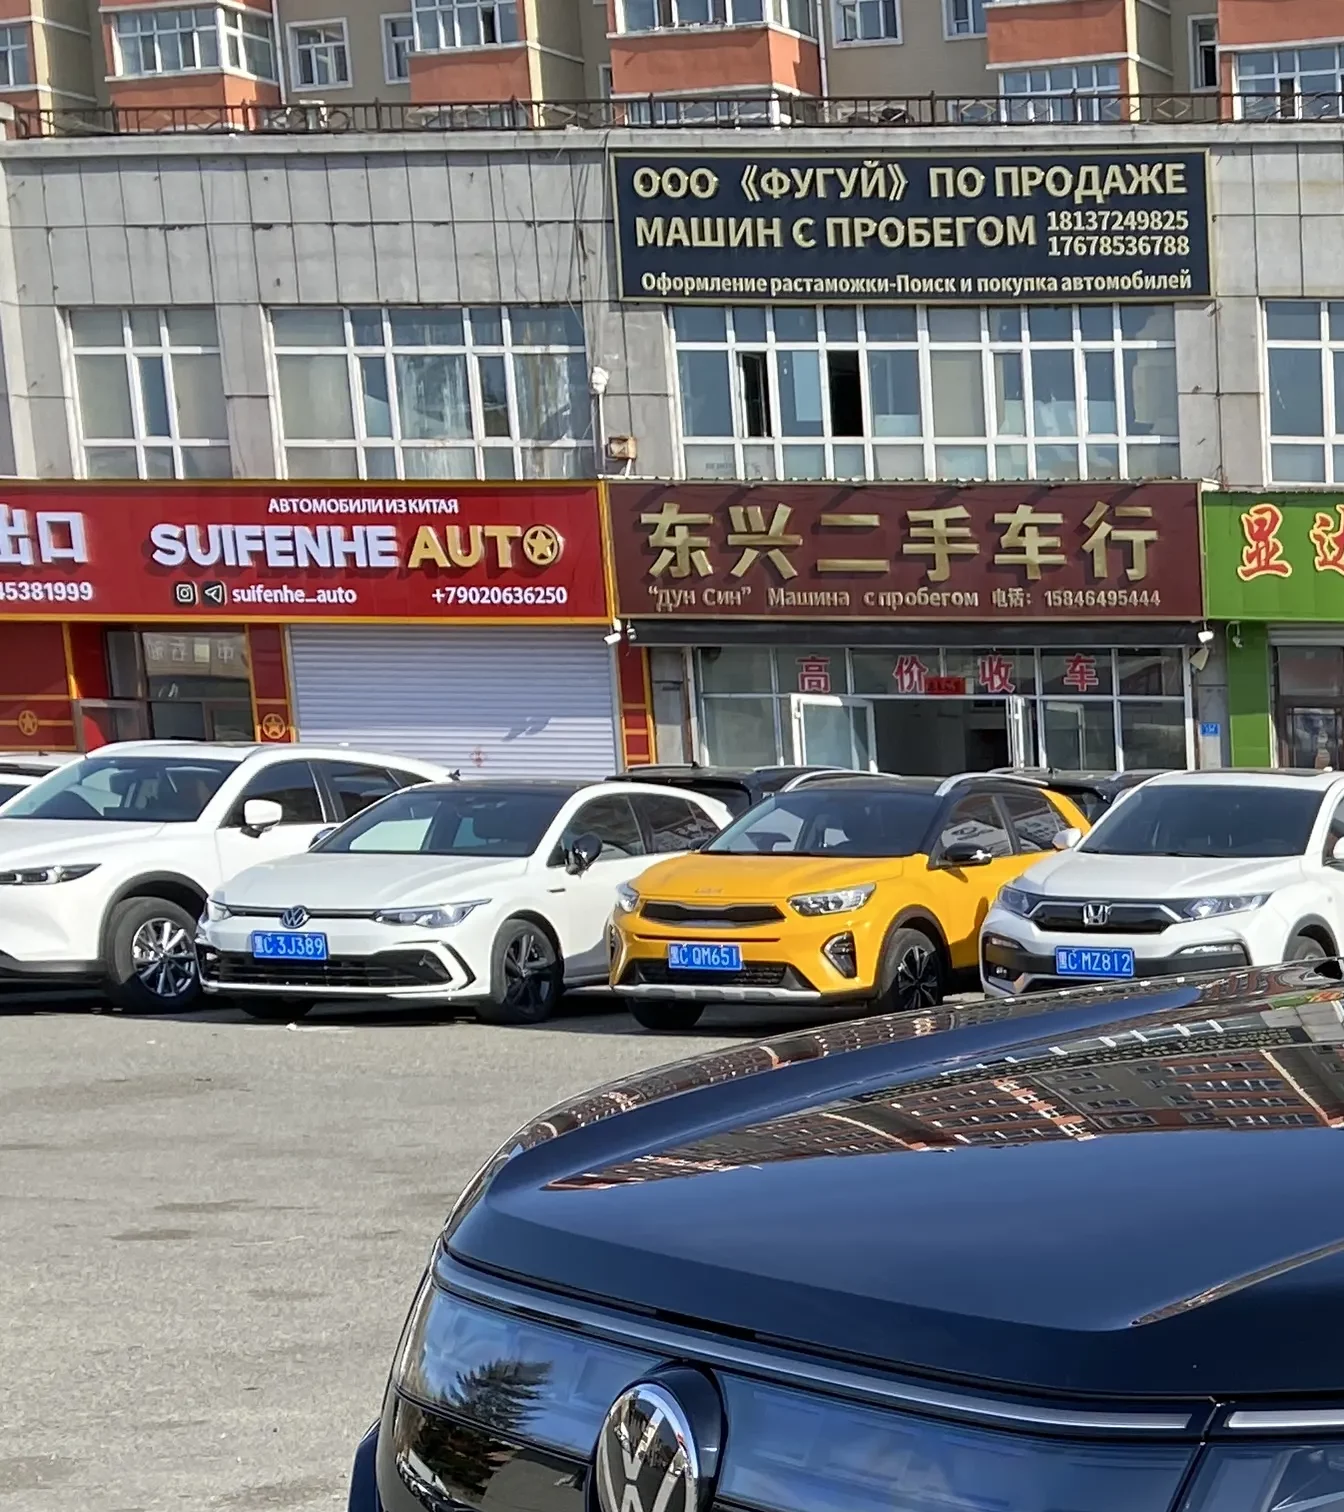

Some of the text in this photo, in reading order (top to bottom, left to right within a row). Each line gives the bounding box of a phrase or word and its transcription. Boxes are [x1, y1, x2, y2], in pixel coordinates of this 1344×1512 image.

[633, 167, 717, 199] ООО
[929, 167, 985, 198] ПО
[995, 163, 1188, 203] ПРОДАЖЕ
[636, 215, 1037, 248] МАШИН С ПРОБЕГОМ
[1046, 210, 1189, 232] 18137249825
[1048, 235, 1190, 257] 17678536788
[641, 272, 769, 296] Оформление
[960, 278, 973, 292] и
[976, 277, 1058, 297] покупка
[1061, 269, 1192, 294] автомобилей
[268, 498, 459, 515] АВТОМОБИЛИ ИЗ КИТАЯ
[0, 503, 88, 565] 出口
[150, 523, 400, 568] SUIFENHE
[640, 502, 1159, 581] 东兴二手车行
[231, 585, 568, 606] suifenhe_auto +79020636250
[768, 588, 850, 608] Машина
[878, 590, 979, 611] пробегом
[1044, 587, 1161, 608] 15846495444
[795, 655, 1100, 694] 高价收车
